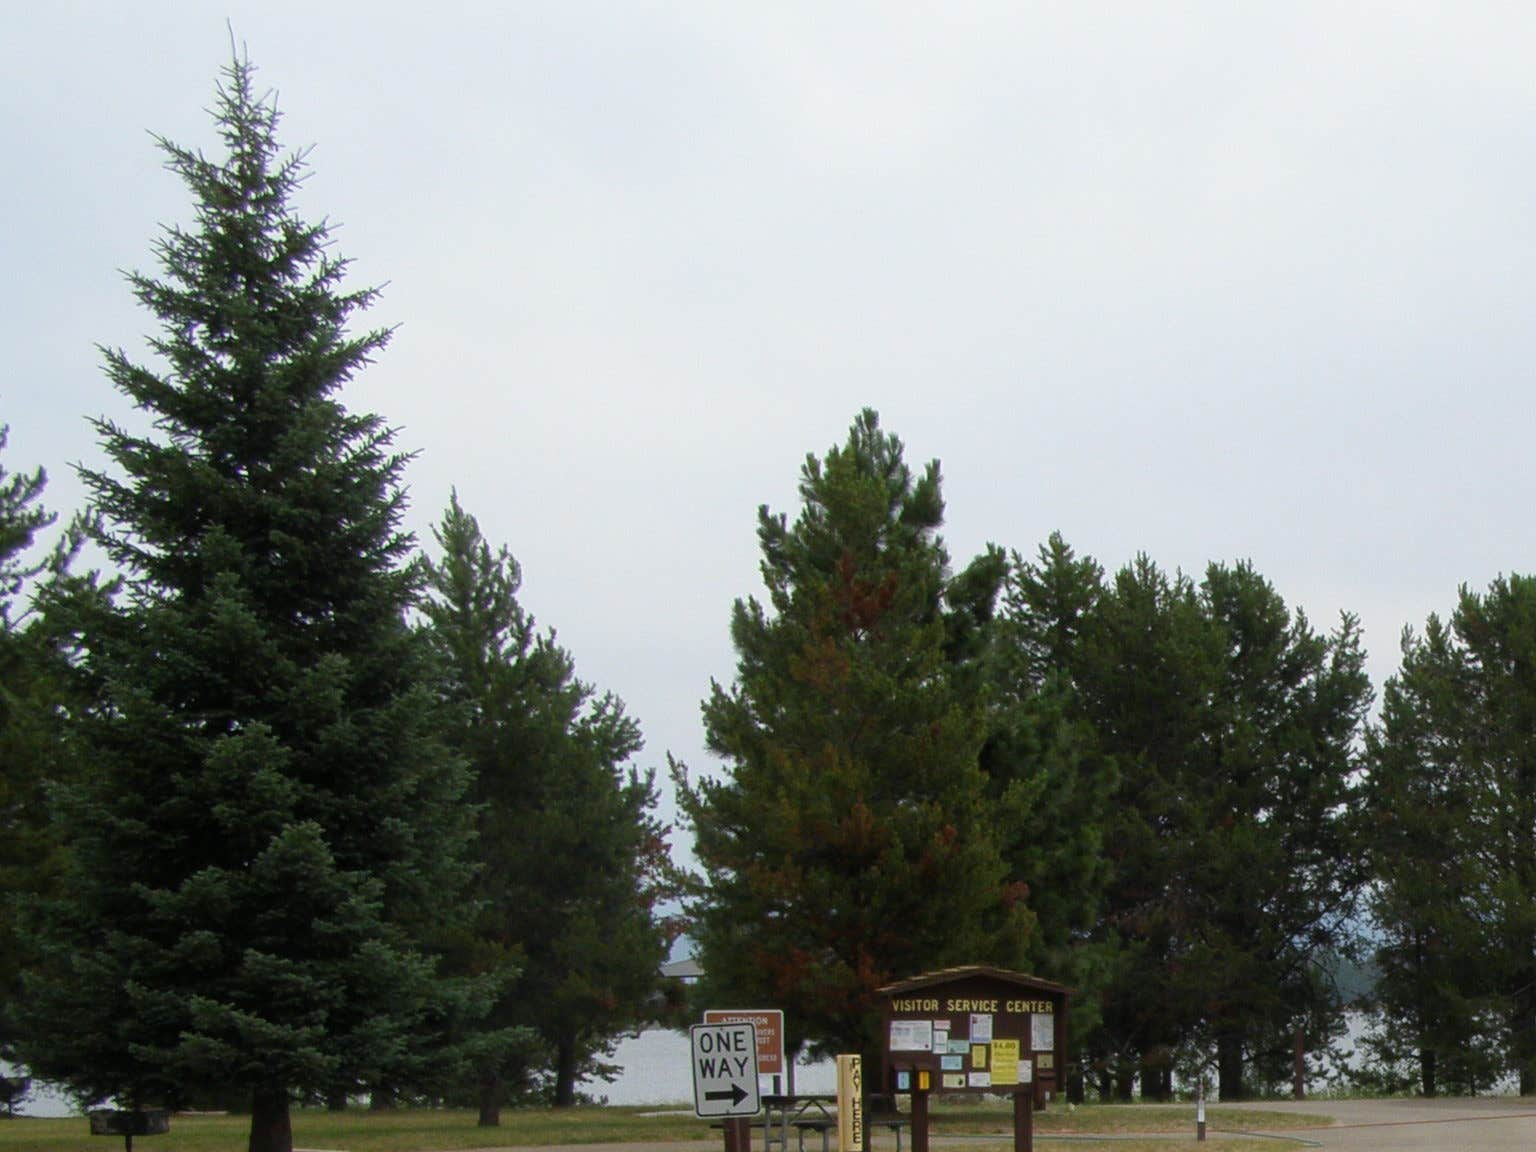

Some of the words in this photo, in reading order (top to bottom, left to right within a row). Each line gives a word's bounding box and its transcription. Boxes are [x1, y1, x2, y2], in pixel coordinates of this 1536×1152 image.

[893, 1000, 939, 1011] VISITOR
[947, 1000, 998, 1012] SERVICE
[1006, 1001, 1053, 1013] CENTER
[700, 1031, 747, 1053] ONE
[699, 1057, 749, 1078] WAY
[851, 1057, 861, 1092] PAY
[851, 1097, 862, 1144] HERE
